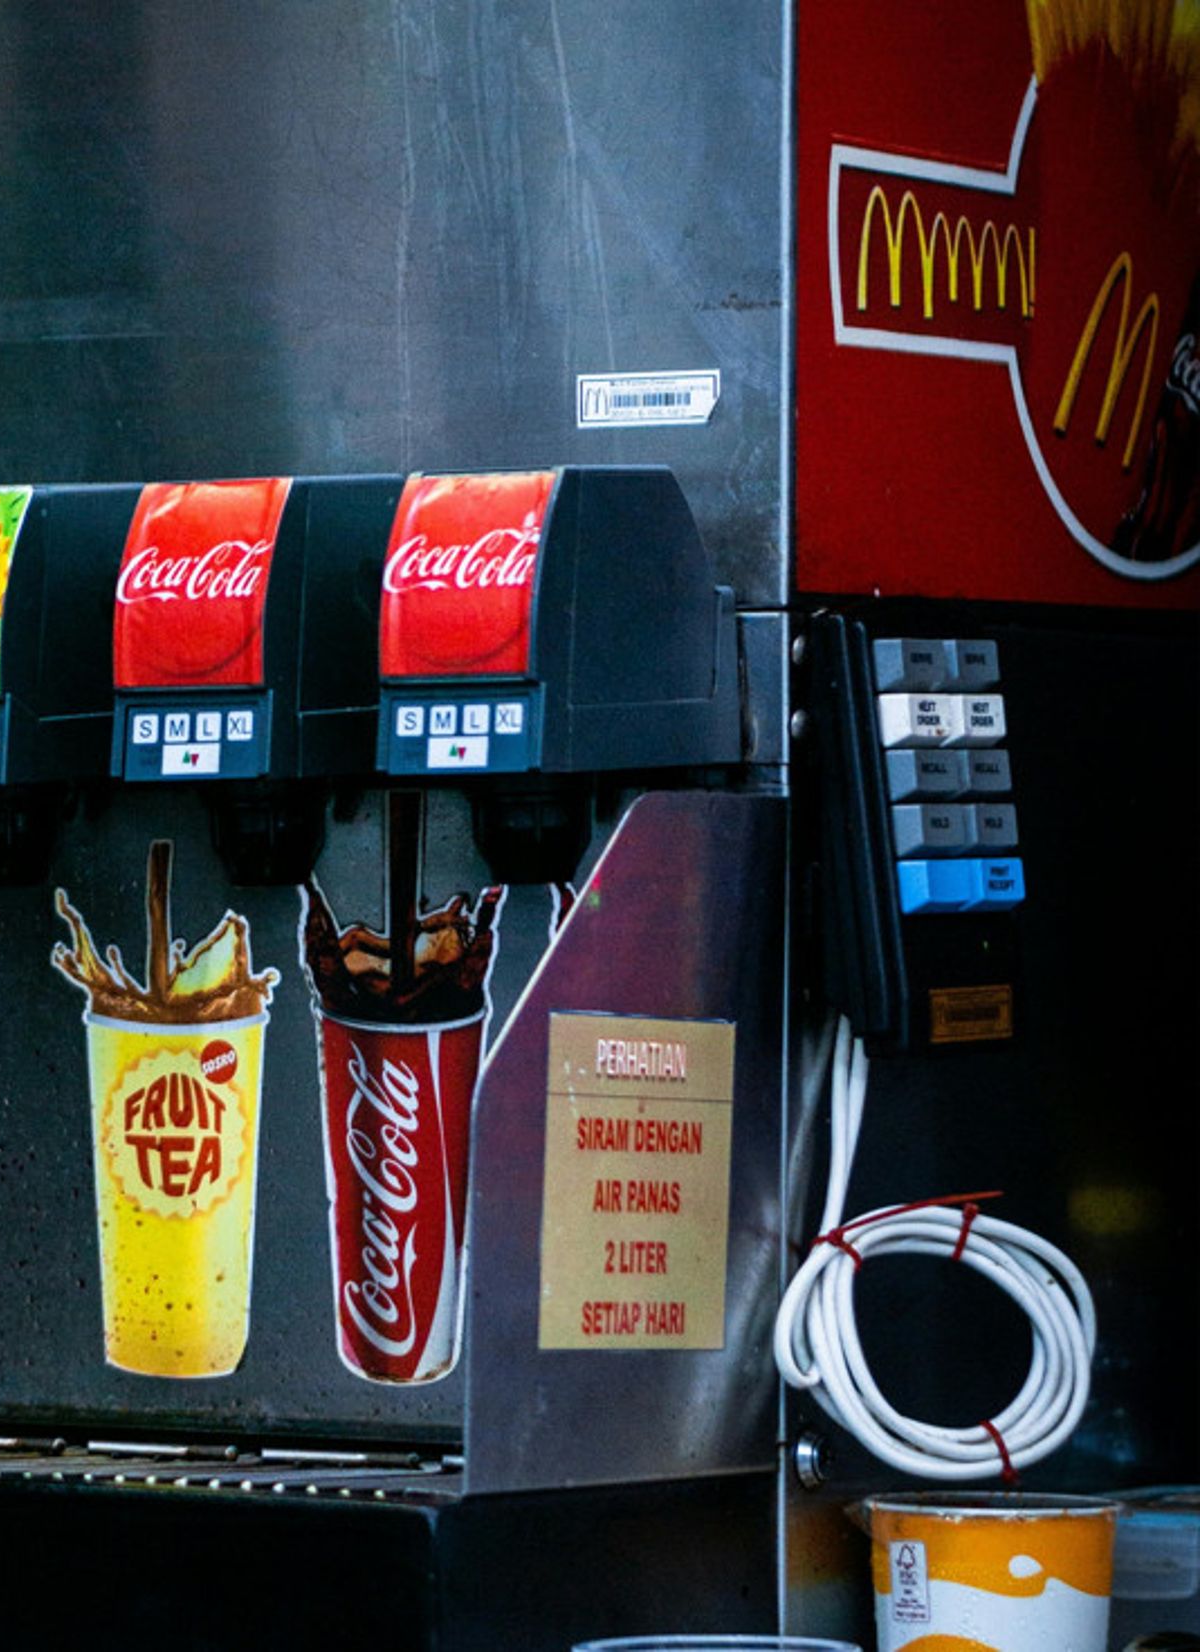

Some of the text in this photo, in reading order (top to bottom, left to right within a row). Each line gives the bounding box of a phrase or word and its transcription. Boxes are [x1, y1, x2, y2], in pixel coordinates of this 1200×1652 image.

[115, 540, 275, 604] Coca-Cola
[383, 528, 541, 593] Coca-Cola
[140, 717, 252, 738] S M L XL
[404, 709, 521, 730] S M L XL
[596, 1038, 687, 1082] PERHATIAN
[125, 1072, 227, 1134] FRUIT
[576, 1117, 703, 1155] SIRAM DENGAN
[125, 1134, 221, 1198] TEA
[343, 1040, 420, 1357] Coca-Cola
[593, 1180, 681, 1214] AIR PANAS
[604, 1241, 667, 1274] 2 LITER
[581, 1302, 685, 1337] SETIAP HARI
